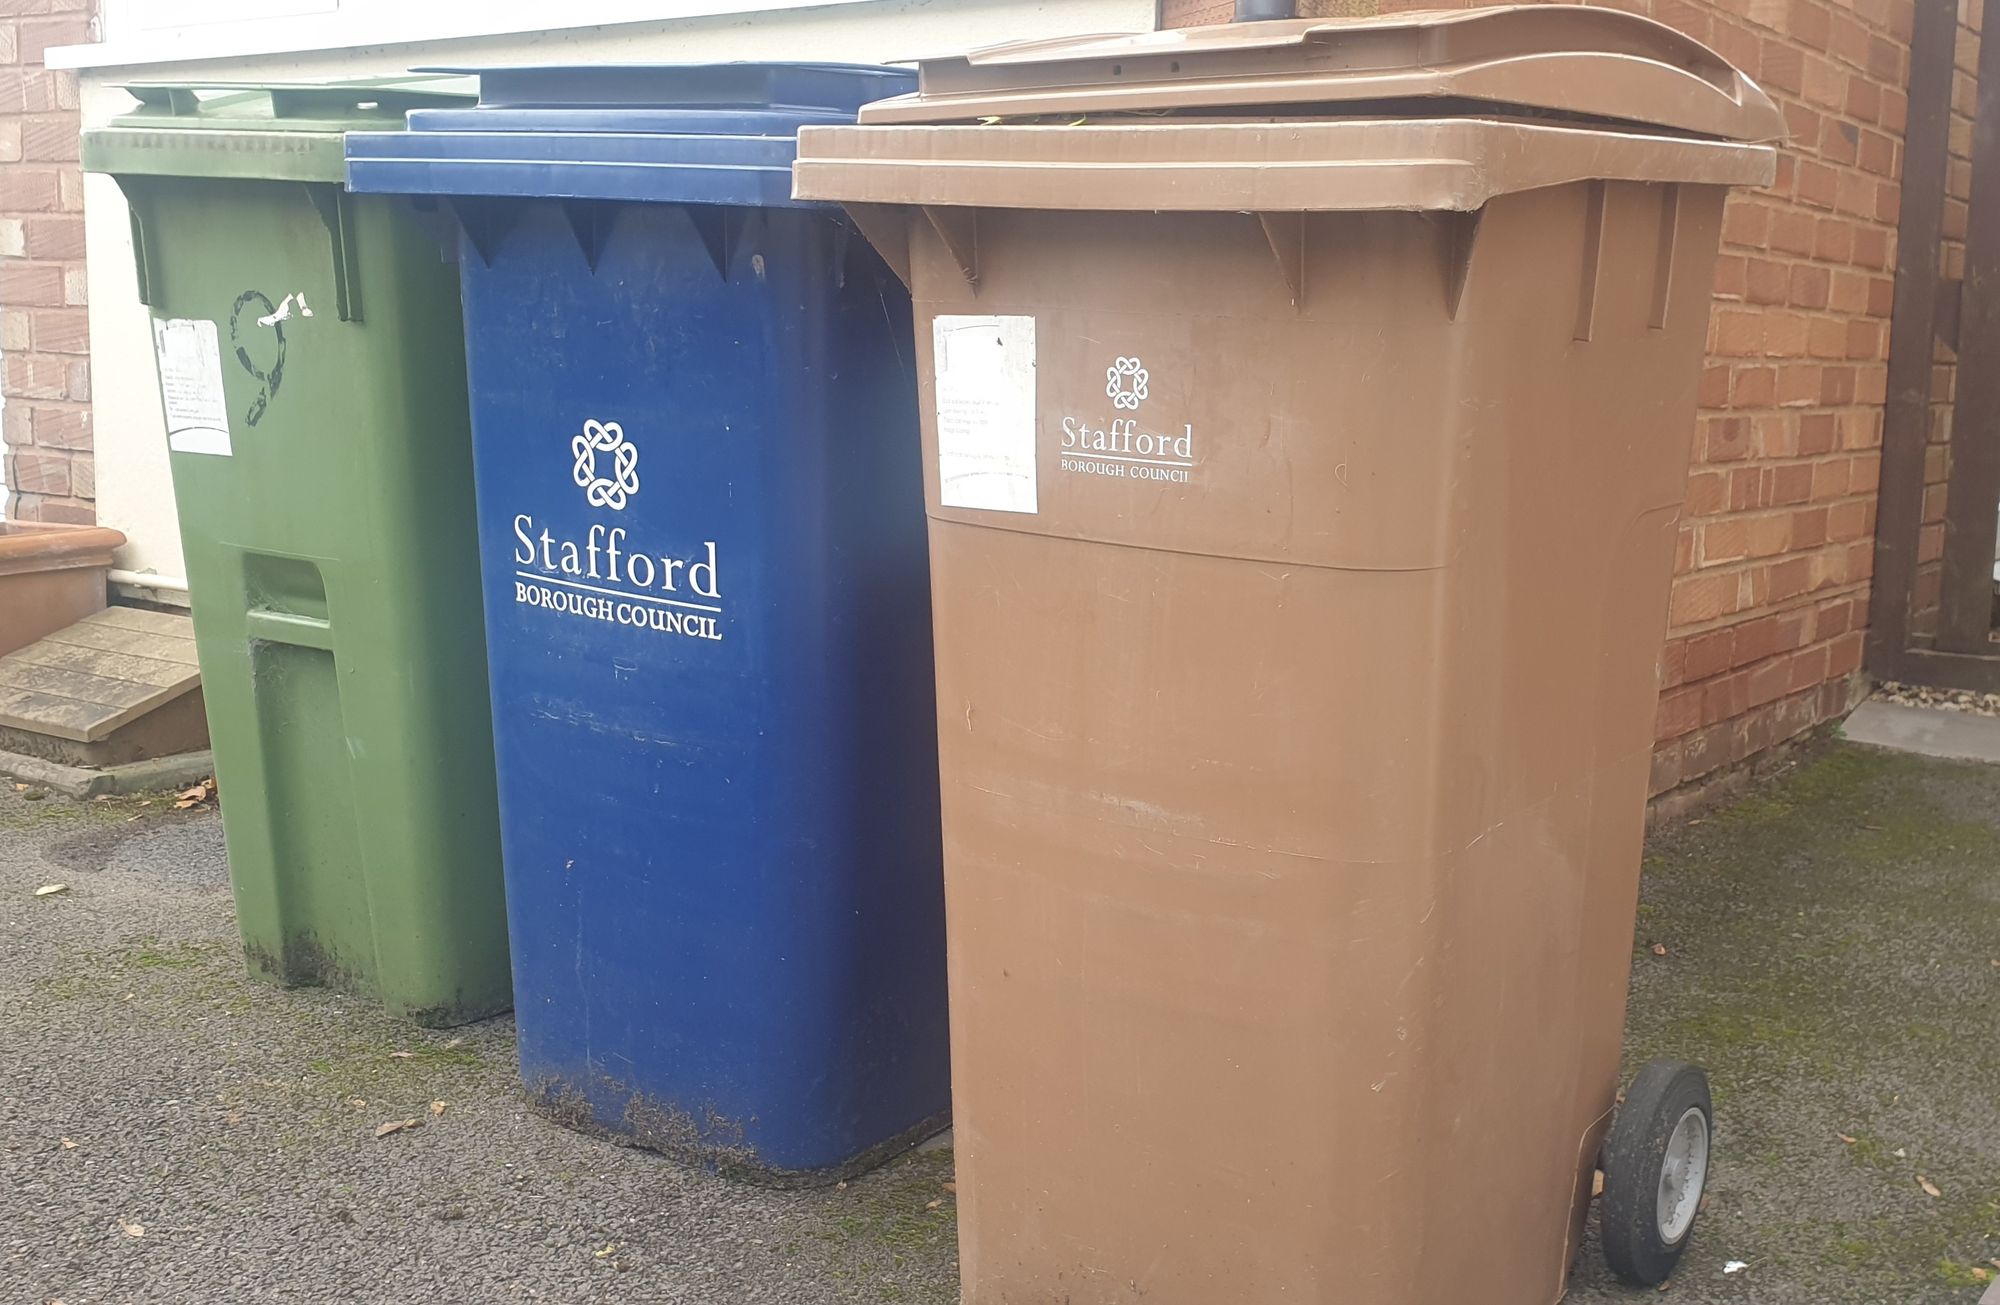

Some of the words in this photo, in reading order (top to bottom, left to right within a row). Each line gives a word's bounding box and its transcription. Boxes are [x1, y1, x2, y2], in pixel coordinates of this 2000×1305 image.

[1061, 416, 1193, 458] Stafford
[1061, 459, 1125, 477] BOROUGH
[514, 514, 722, 598] Stafford
[515, 582, 614, 622] BOROUGH
[616, 603, 722, 640] COUNCIL
